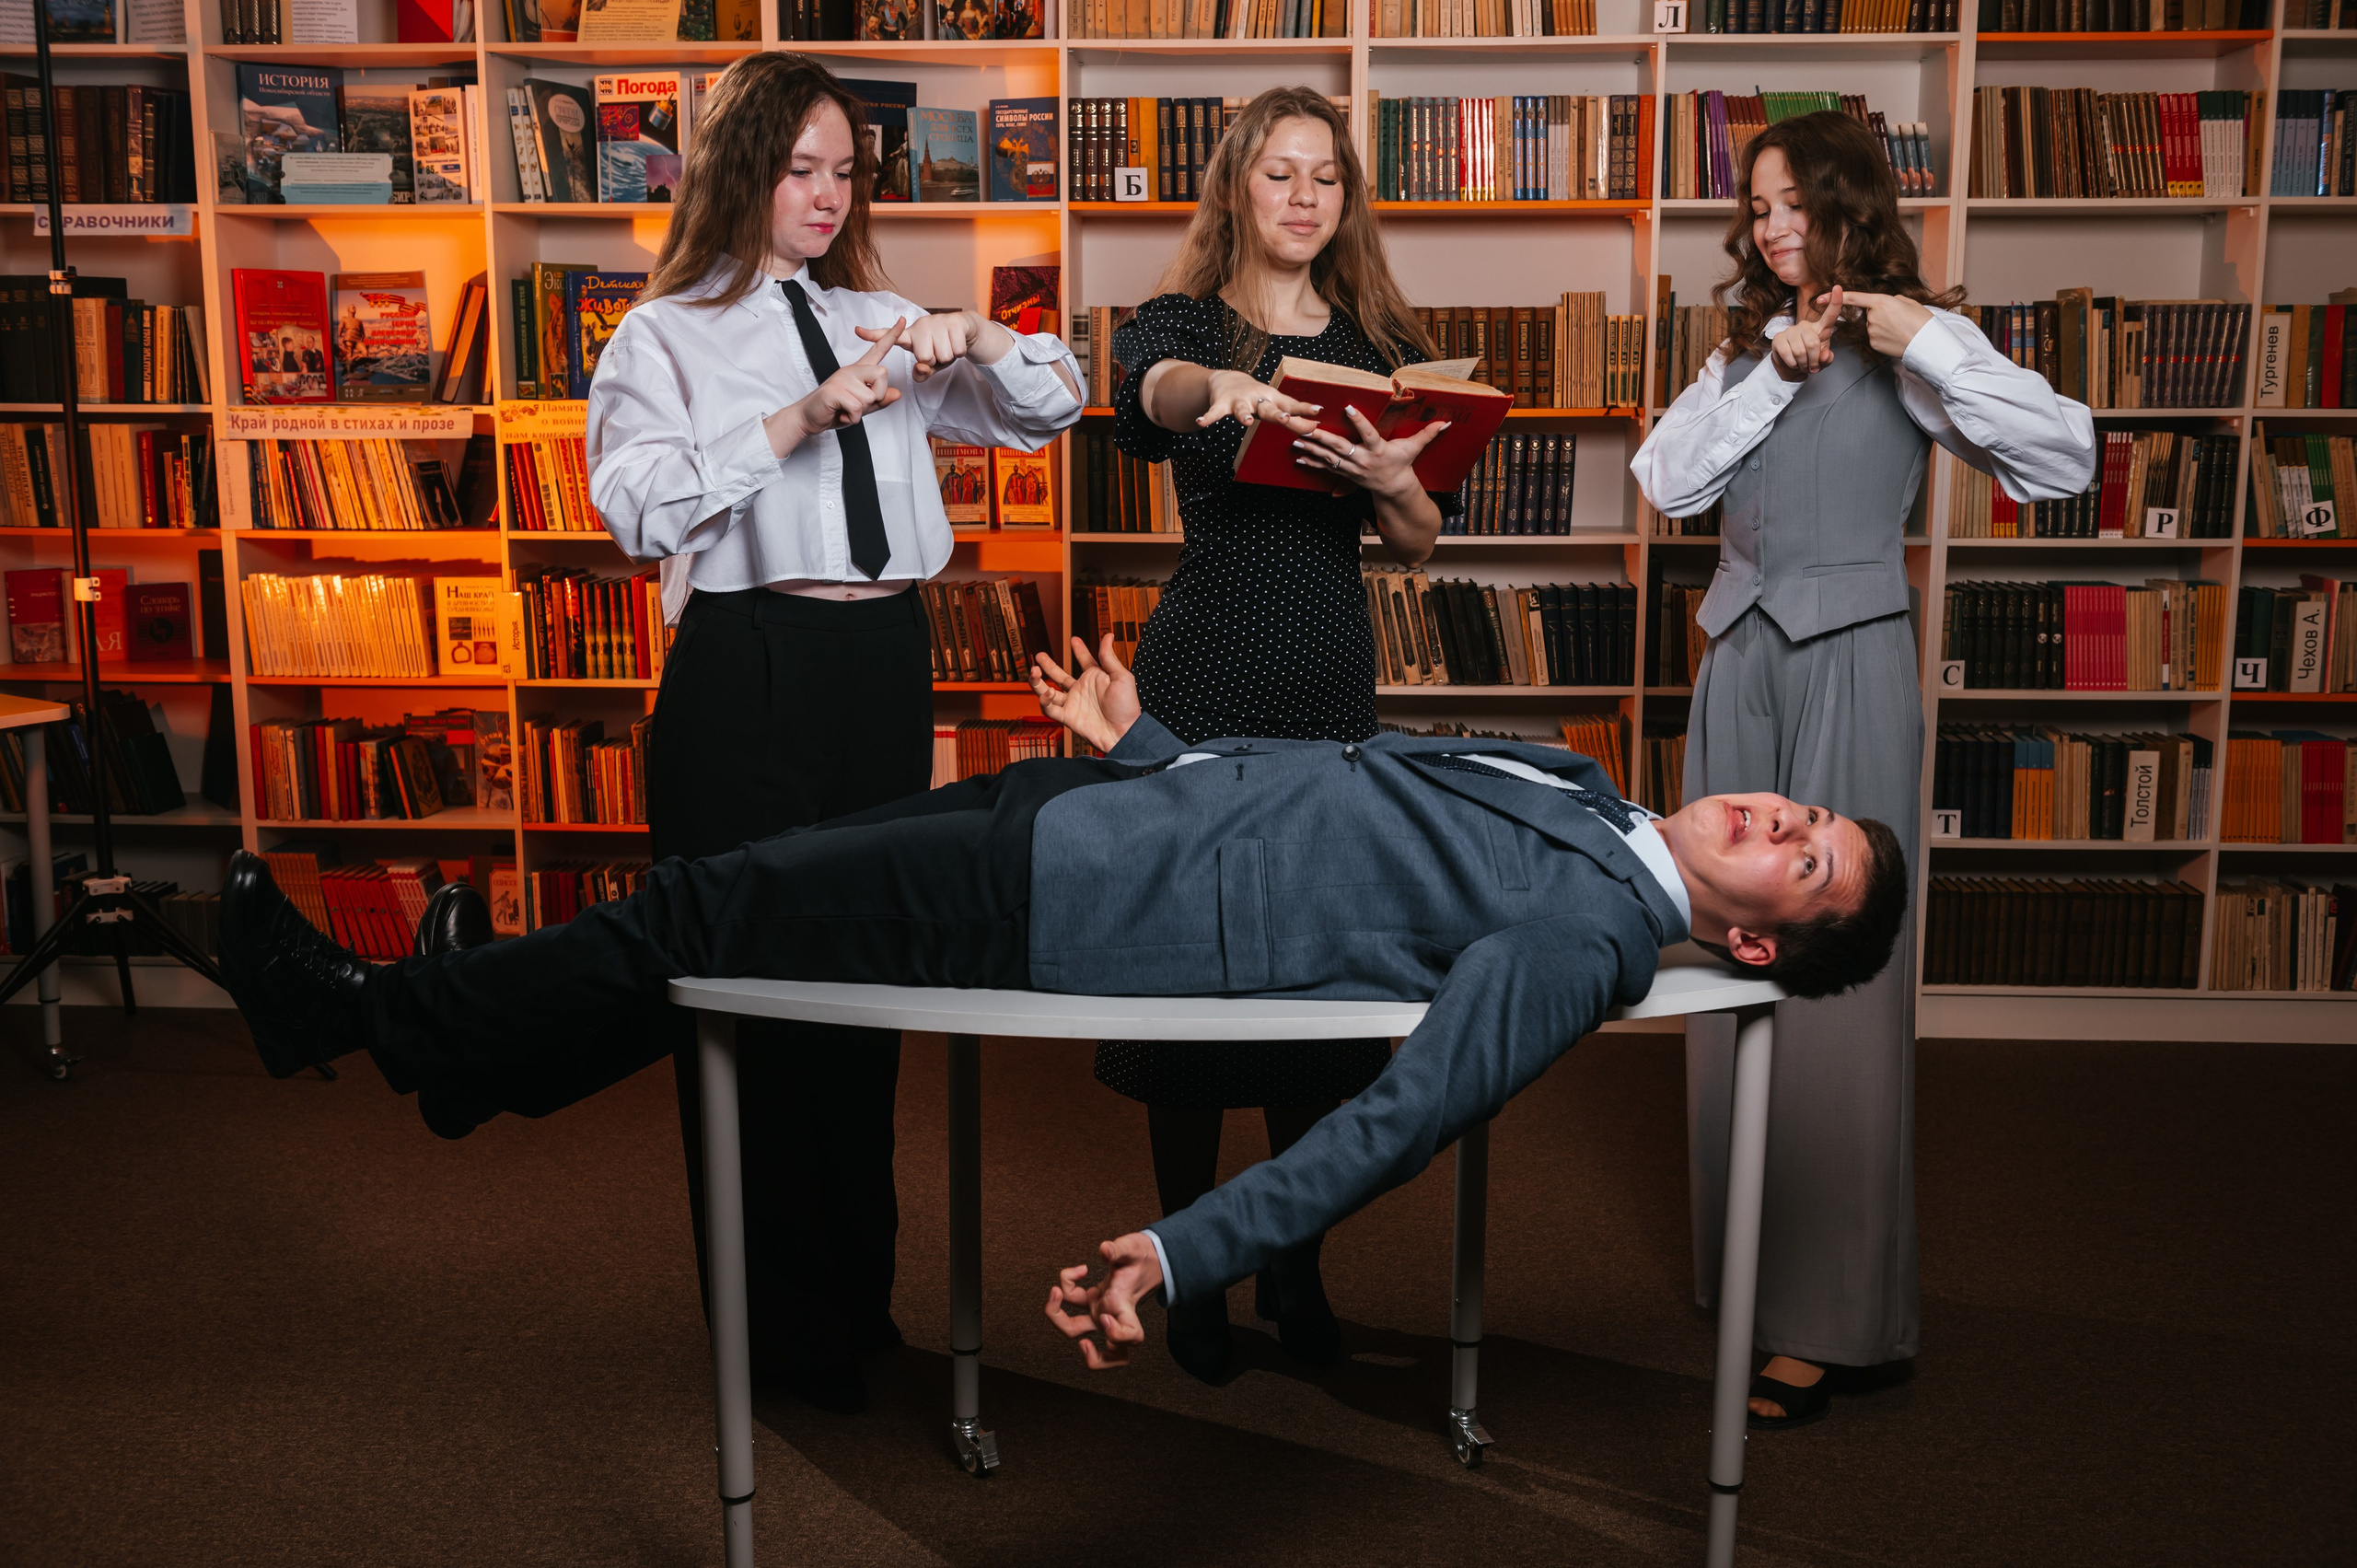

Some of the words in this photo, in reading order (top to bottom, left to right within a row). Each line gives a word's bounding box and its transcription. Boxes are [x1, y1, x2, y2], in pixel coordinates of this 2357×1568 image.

[1658, 6, 1679, 28] Л
[259, 73, 330, 89] ИСТОРИЯ
[618, 79, 677, 95] Погода
[921, 110, 972, 123] МОСКВА
[995, 114, 1028, 122] СИМВОЛЫ
[1029, 112, 1053, 121] РОССИИ
[930, 122, 948, 132] ДЛЯ
[951, 125, 972, 134] ВСЕХ
[2345, 99, 2354, 155] ВОСКРЕСЕНИЕ
[929, 134, 973, 143] СТОЛИЦА
[1125, 175, 1142, 195] Б
[38, 215, 174, 228] СРАВОЧНИКИ
[586, 275, 648, 289] Детская
[520, 324, 528, 377] ЭНЦИКЛОПЕДИЯ
[2260, 325, 2279, 399] Тургенев
[542, 403, 587, 412] Память
[232, 414, 267, 432] Край
[273, 414, 325, 432] родной
[331, 419, 339, 429] в
[344, 419, 394, 430] стихах
[400, 419, 407, 429] и
[412, 419, 455, 433] прозе
[17, 445, 26, 468] ЯЗЫК
[20, 470, 31, 507] РУССКИЙ
[2156, 513, 2173, 533] Р
[2306, 506, 2331, 528] Ф
[140, 595, 180, 605] Словарь
[155, 605, 182, 613] этике
[955, 606, 968, 648] РЕЗЕРФОРД
[1009, 629, 1019, 647] 1000
[2297, 630, 2317, 679] Чехов
[2311, 608, 2321, 625] А.
[503, 663, 511, 674] 63.
[1943, 665, 1959, 685] С
[2242, 663, 2259, 683] Ч
[2131, 764, 2153, 829] Толстой
[1938, 815, 1956, 833] Т
